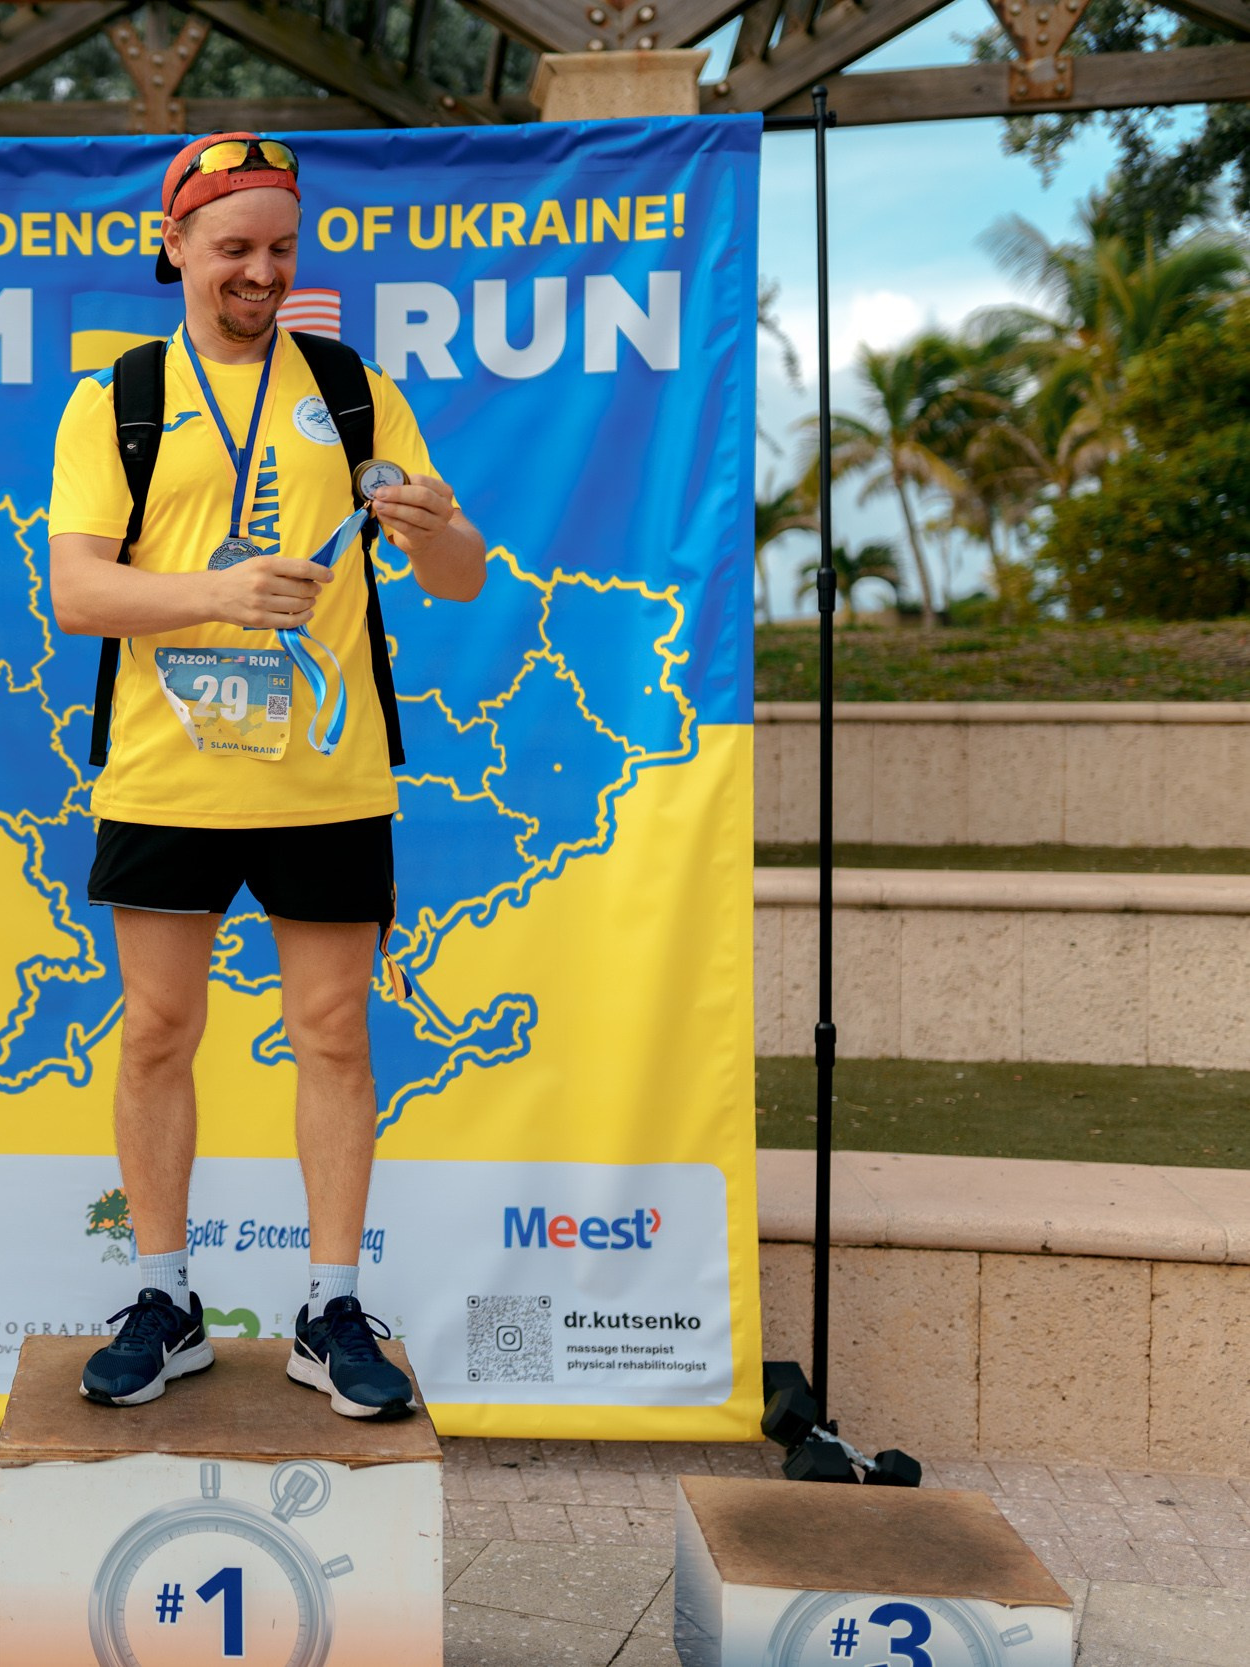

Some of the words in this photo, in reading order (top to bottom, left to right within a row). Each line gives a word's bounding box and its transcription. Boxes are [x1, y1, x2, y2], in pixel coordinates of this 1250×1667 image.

[318, 206, 395, 252] OF
[408, 193, 687, 250] UKRAINE!
[375, 270, 681, 381] RUN
[168, 654, 218, 666] RAZOM
[249, 656, 280, 668] RUN
[272, 677, 286, 686] 5K
[192, 674, 249, 722] 29
[210, 741, 239, 750] SLAVA
[241, 744, 282, 755] UKRAINI!
[504, 1206, 654, 1251] Meest
[564, 1311, 701, 1330] dr.kutsenko
[567, 1344, 619, 1355] massage
[621, 1343, 675, 1356] therapist
[567, 1359, 616, 1371] physical
[618, 1359, 707, 1372] rehabilitologist
[155, 1567, 244, 1656] #1
